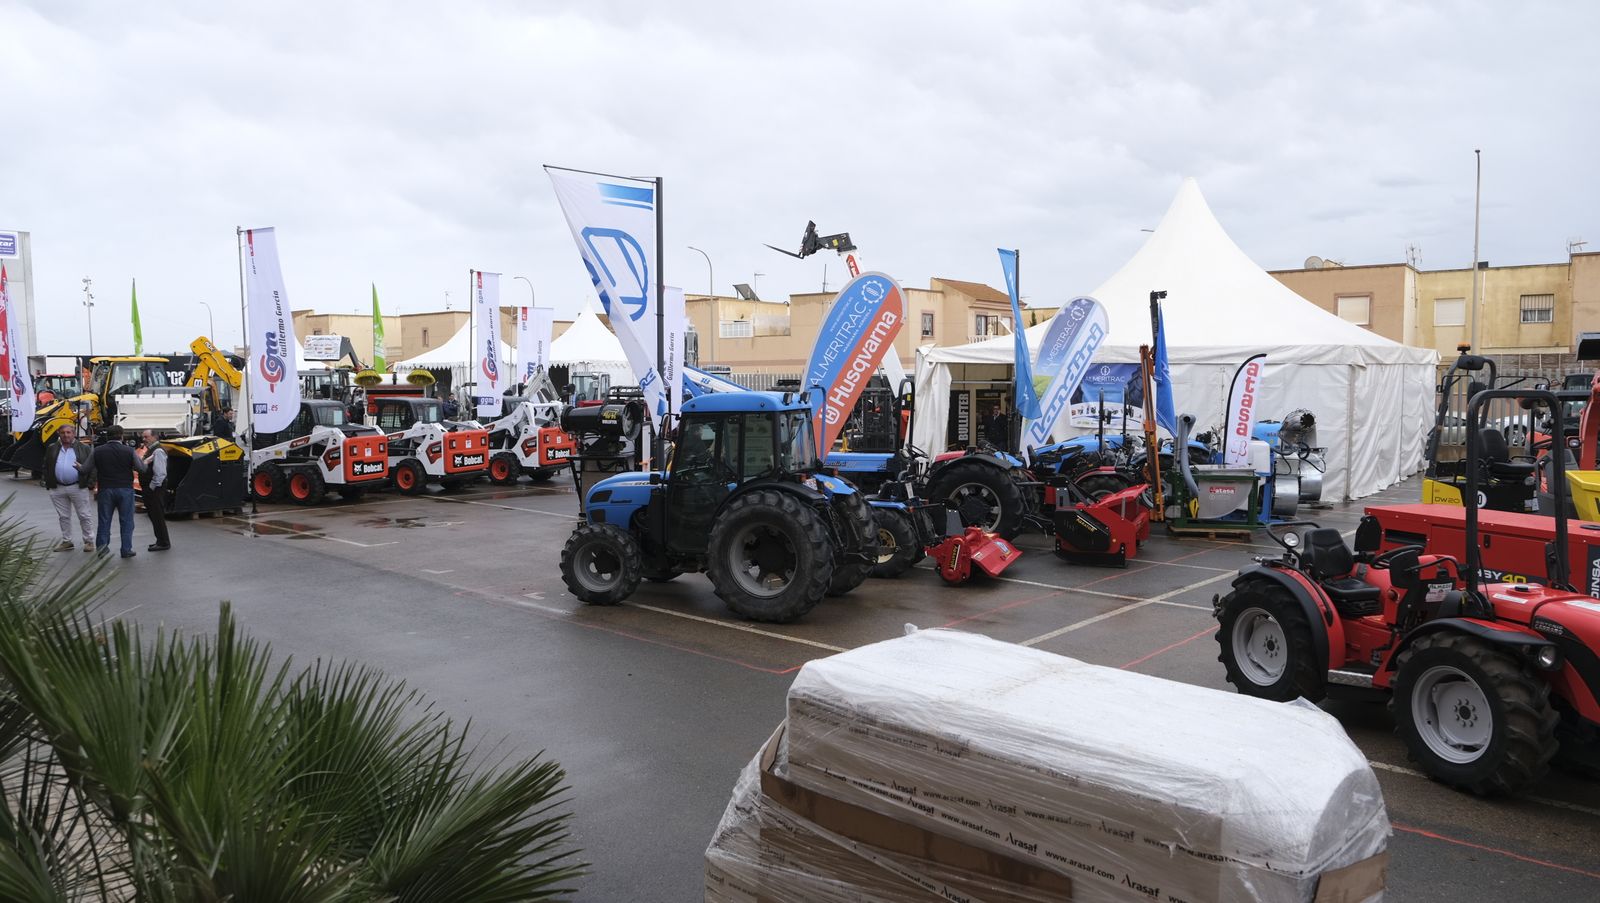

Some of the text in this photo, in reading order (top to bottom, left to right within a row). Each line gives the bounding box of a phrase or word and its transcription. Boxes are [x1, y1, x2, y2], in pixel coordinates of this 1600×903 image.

[280, 317, 288, 358] Guillermo
[810, 302, 867, 386] ALMERITRAC
[829, 310, 897, 407] Husqvarna
[667, 351, 675, 381] Guillermo
[958, 393, 969, 441] BULLIFTER
[1236, 362, 1260, 437] atasa
[363, 463, 384, 474] Bobcat
[463, 455, 484, 466] Bobcat
[1434, 496, 1461, 505] DW20
[891, 780, 917, 796] Arasaf
[986, 799, 1017, 816] Arasaf
[1024, 808, 1093, 829] www.arasaf.com
[1098, 820, 1136, 841] Arasaf
[907, 797, 935, 815] Arasaf
[941, 811, 1001, 840] www.arasaf.com
[1005, 832, 1038, 854] Arasaf
[1045, 848, 1116, 881] www.arasaf.com
[1121, 873, 1161, 899] Arasaf
